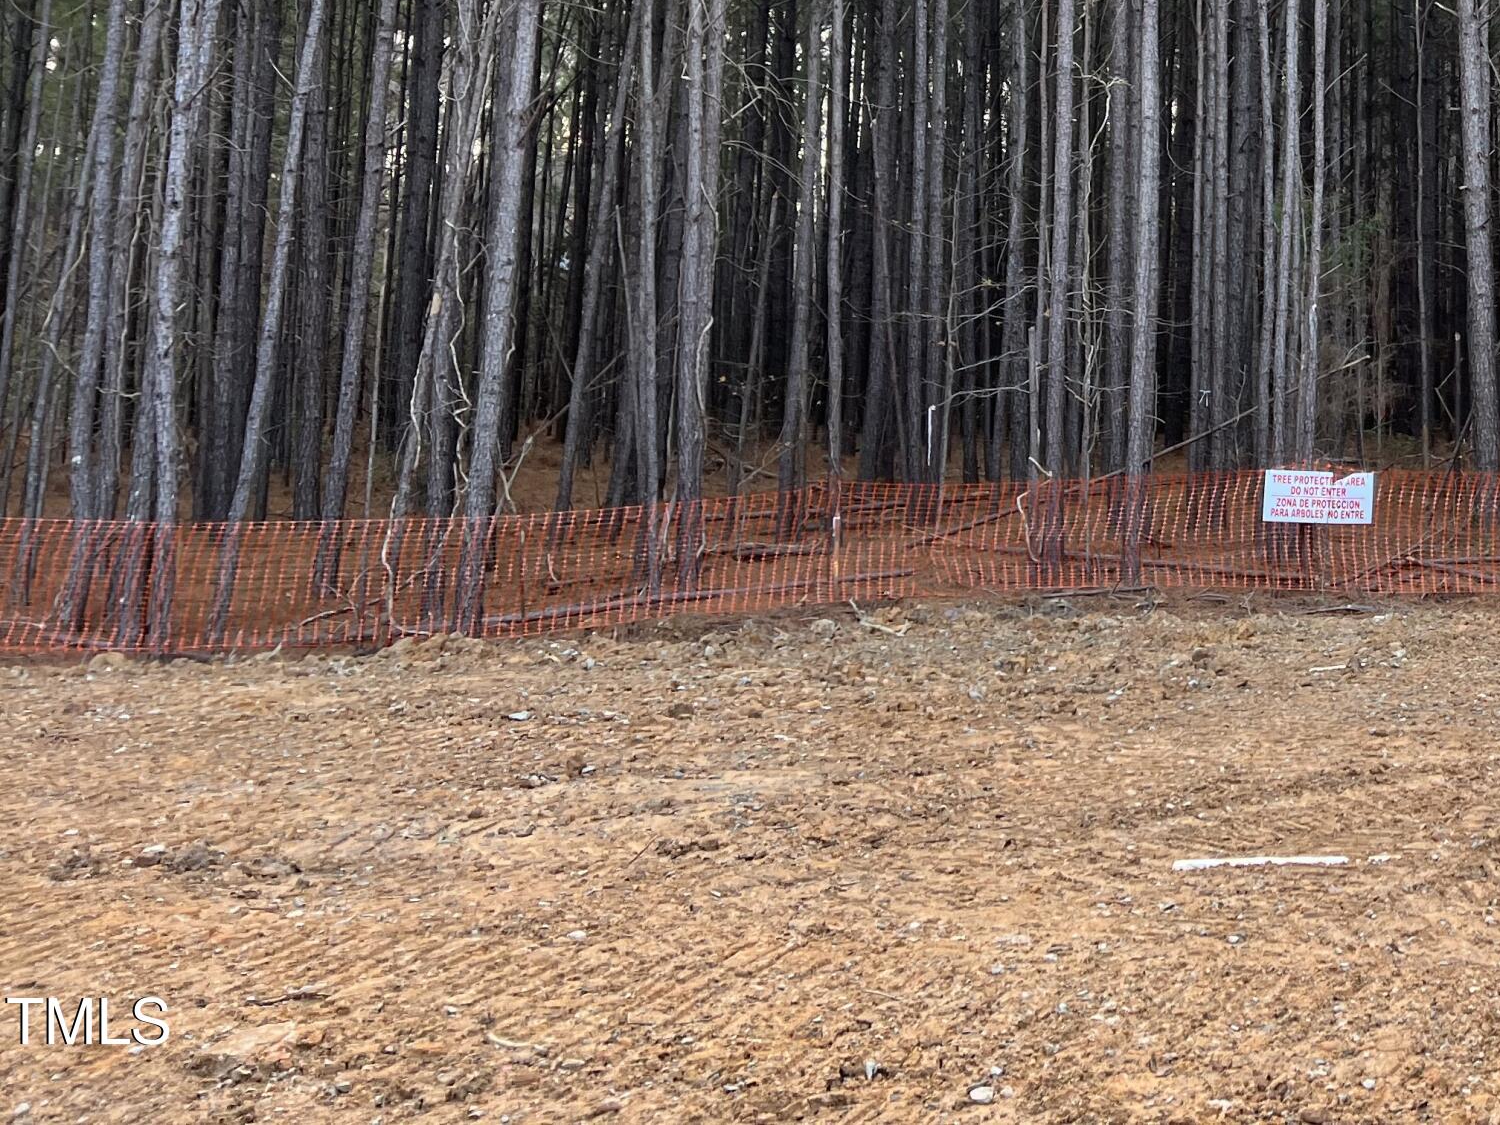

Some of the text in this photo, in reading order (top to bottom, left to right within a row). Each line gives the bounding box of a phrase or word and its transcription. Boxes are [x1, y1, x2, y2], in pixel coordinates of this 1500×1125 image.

[1272, 475, 1365, 486] TREE PROTECTI AREA
[1290, 486, 1347, 497] DO NOT ENTER
[1276, 498, 1297, 507] ZONA
[1299, 499, 1309, 508] DE
[1270, 508, 1365, 519] PARA ARBOLES NO ENTRE
